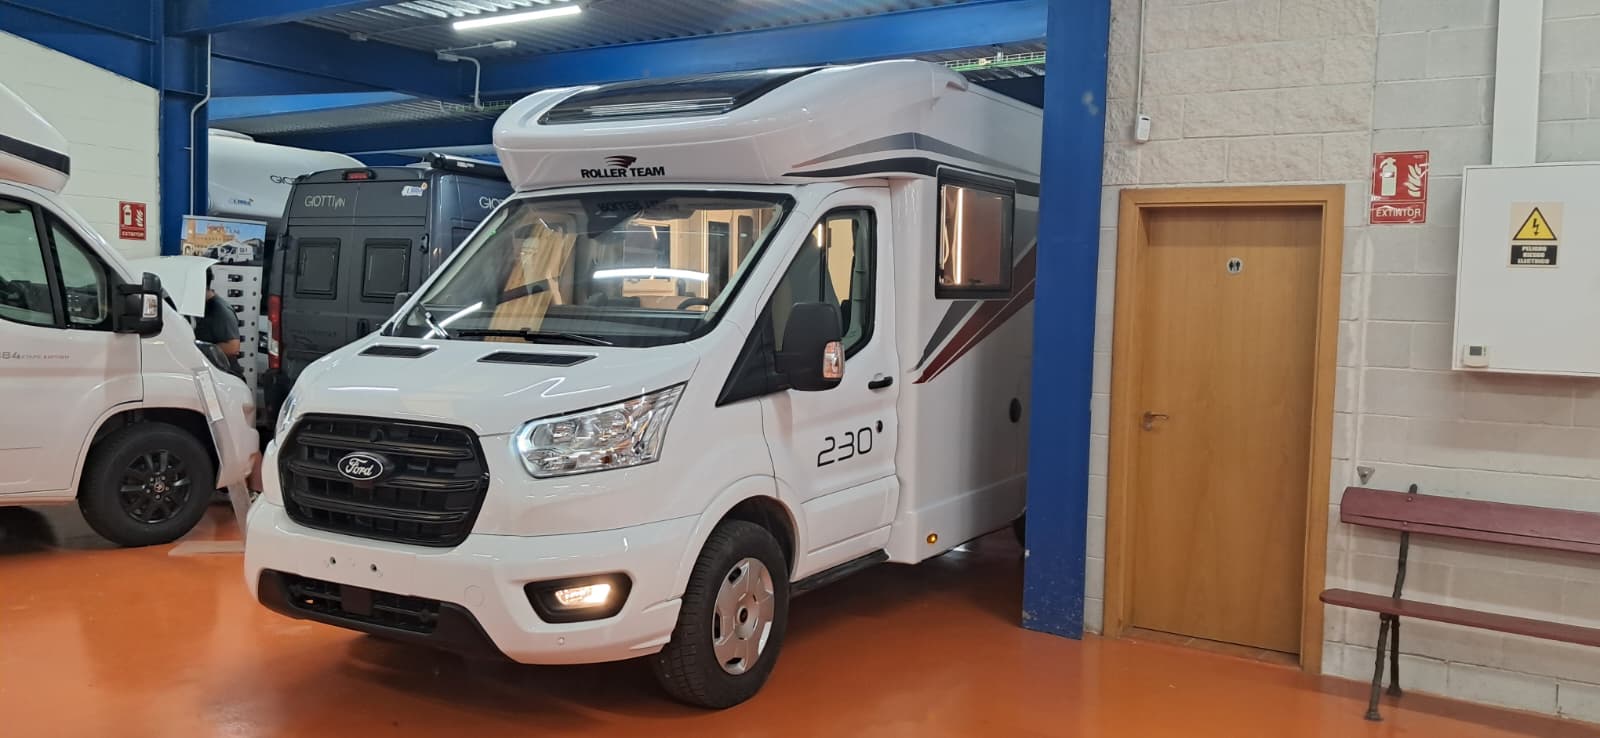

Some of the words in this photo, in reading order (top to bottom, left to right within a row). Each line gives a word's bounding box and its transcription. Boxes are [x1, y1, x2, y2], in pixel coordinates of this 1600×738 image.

[581, 168, 627, 178] ROLLER
[630, 166, 665, 177] TEAM
[1375, 207, 1421, 217] EXTINTOR
[817, 426, 873, 467] 230
[345, 457, 374, 476] Ford
